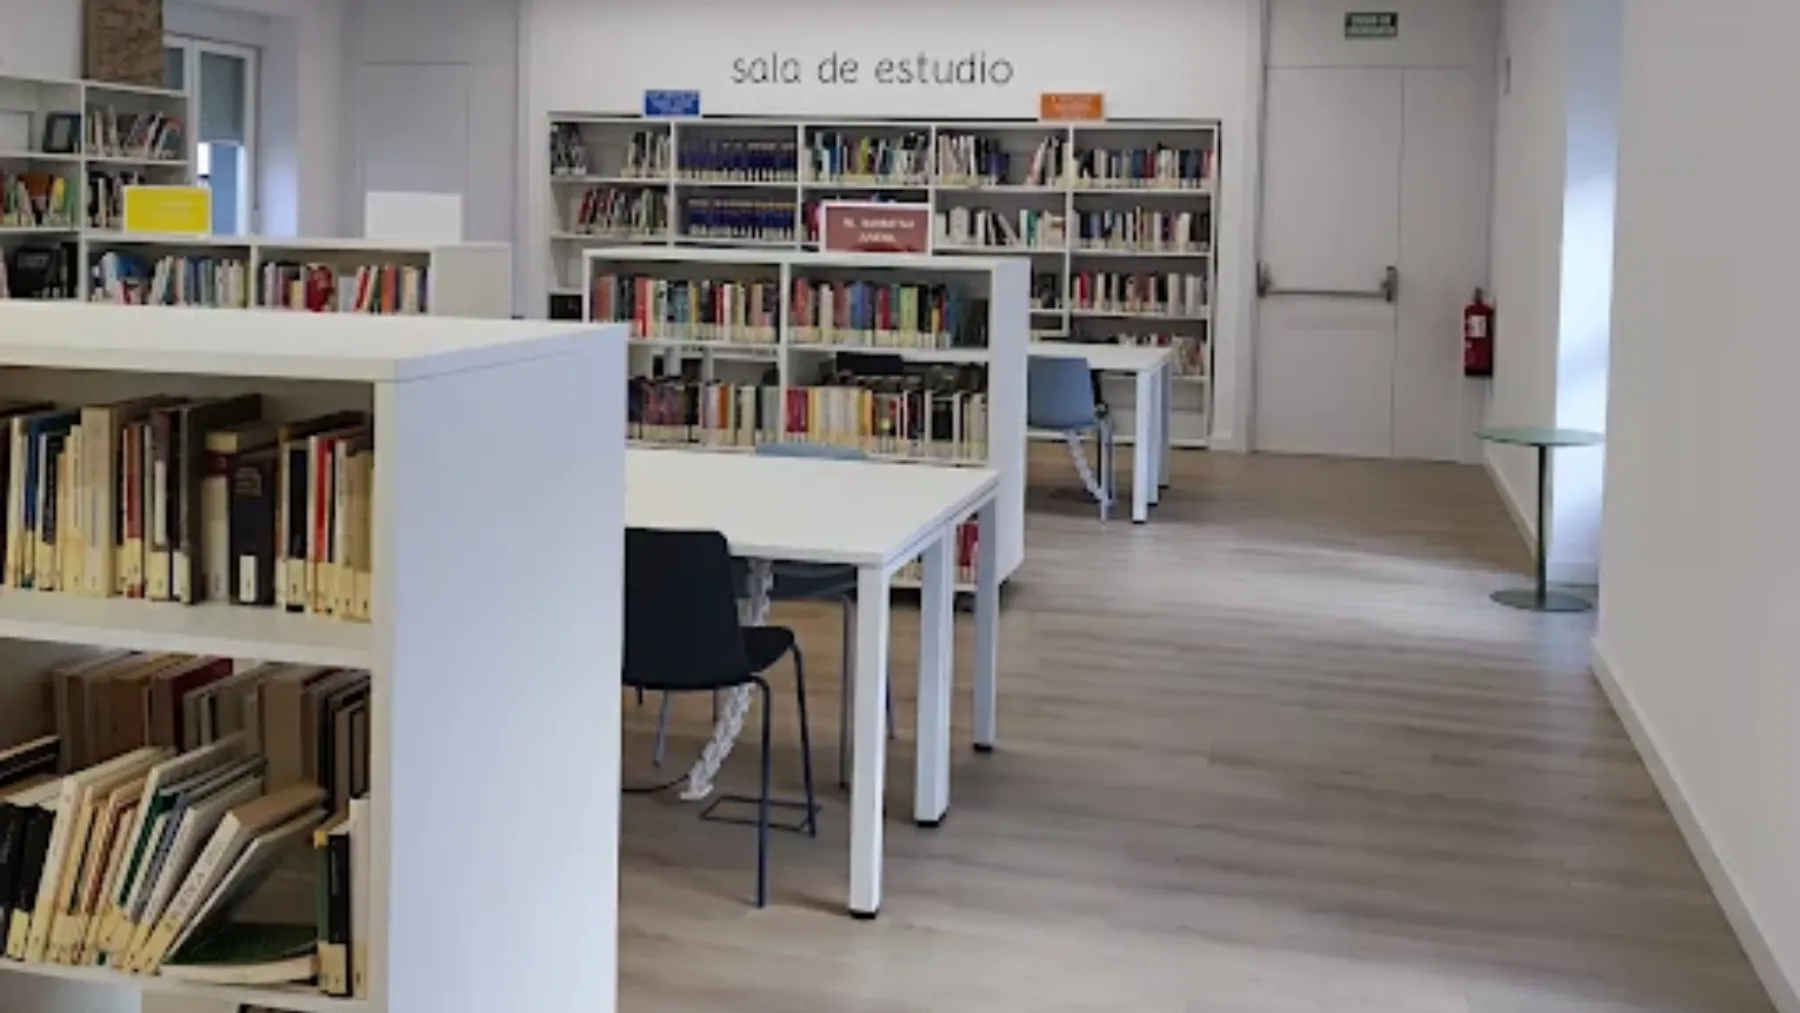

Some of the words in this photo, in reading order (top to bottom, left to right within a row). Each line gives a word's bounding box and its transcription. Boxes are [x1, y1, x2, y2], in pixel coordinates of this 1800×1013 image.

[730, 51, 801, 85] sala
[817, 51, 860, 85] de
[874, 51, 1014, 85] estudio
